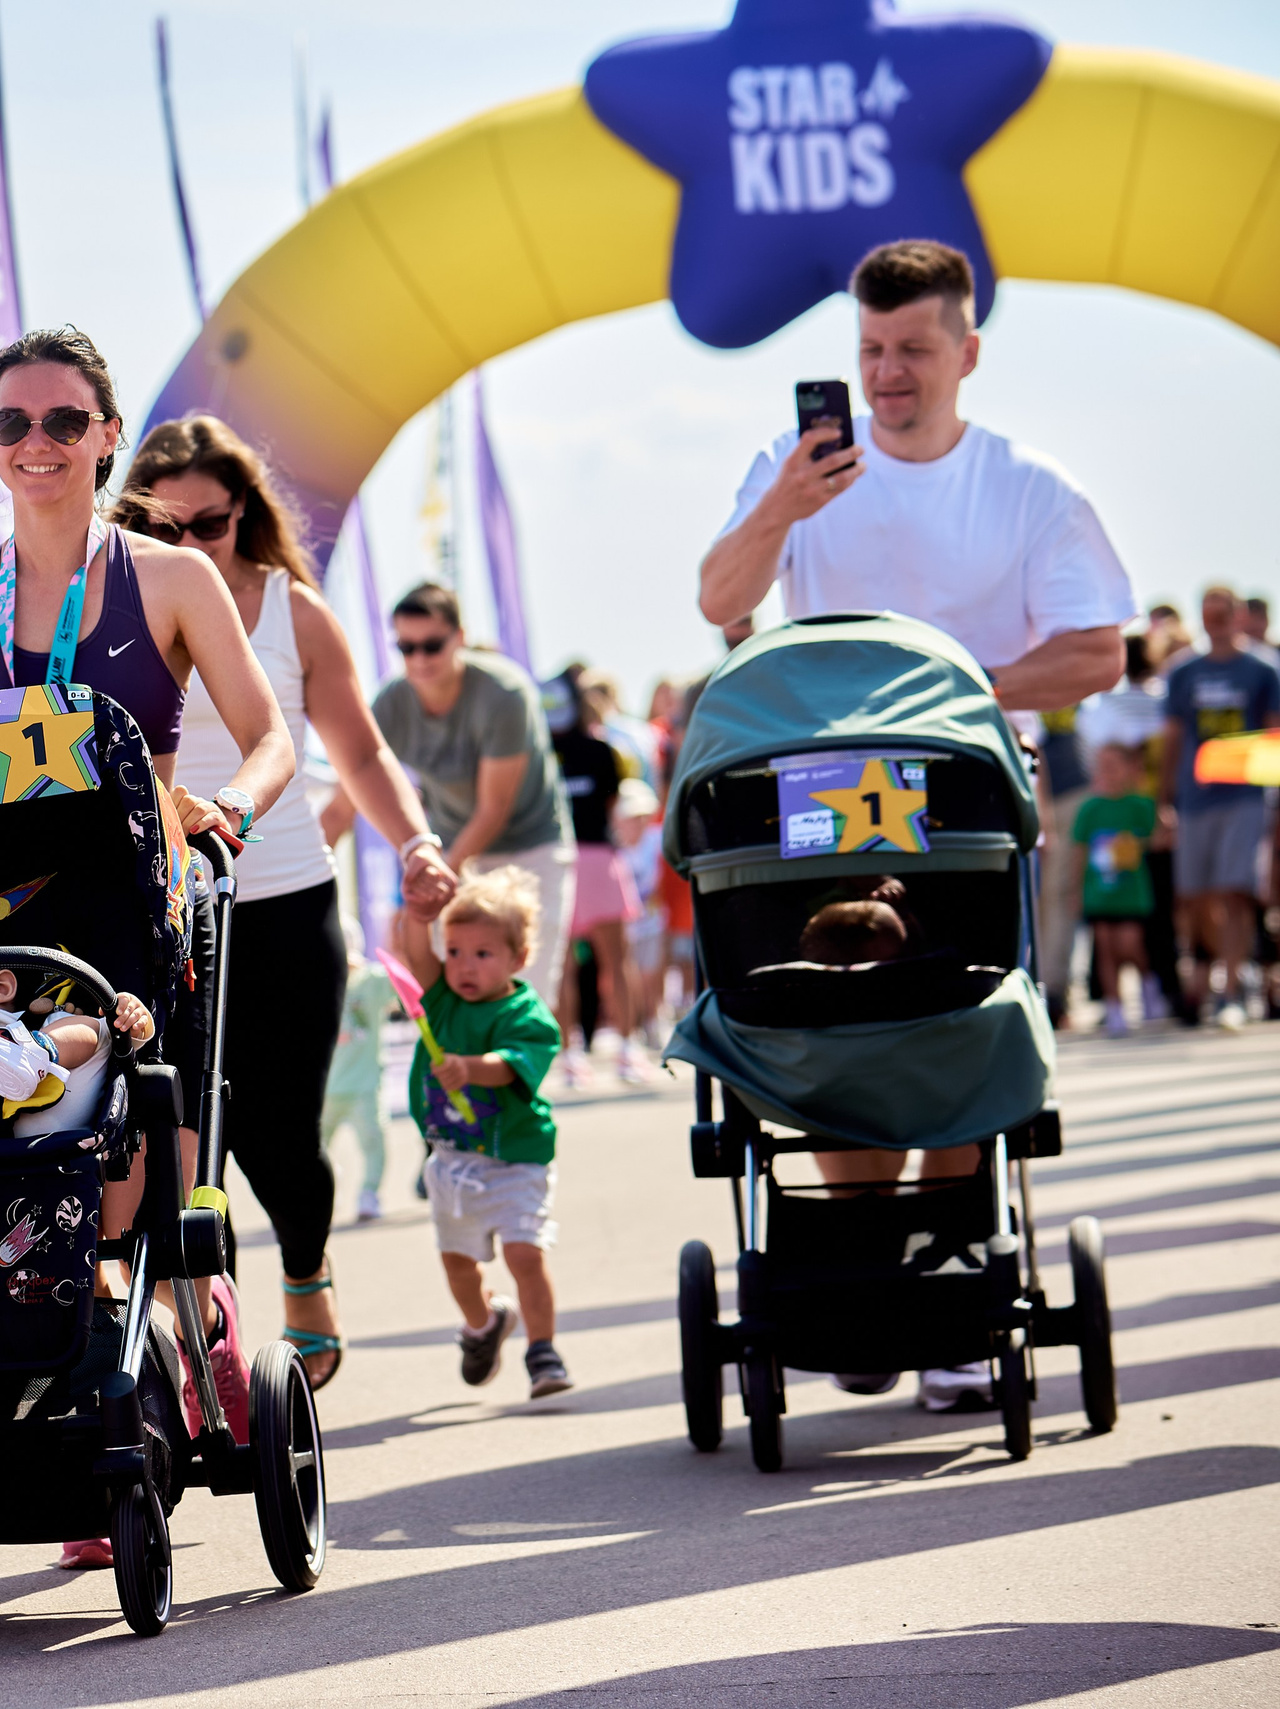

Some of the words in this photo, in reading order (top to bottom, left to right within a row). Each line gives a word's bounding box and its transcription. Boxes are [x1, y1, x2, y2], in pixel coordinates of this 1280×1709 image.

[727, 61, 859, 131] STAR
[729, 122, 896, 214] KIDS
[21, 722, 47, 766] 1
[861, 792, 881, 825] 1
